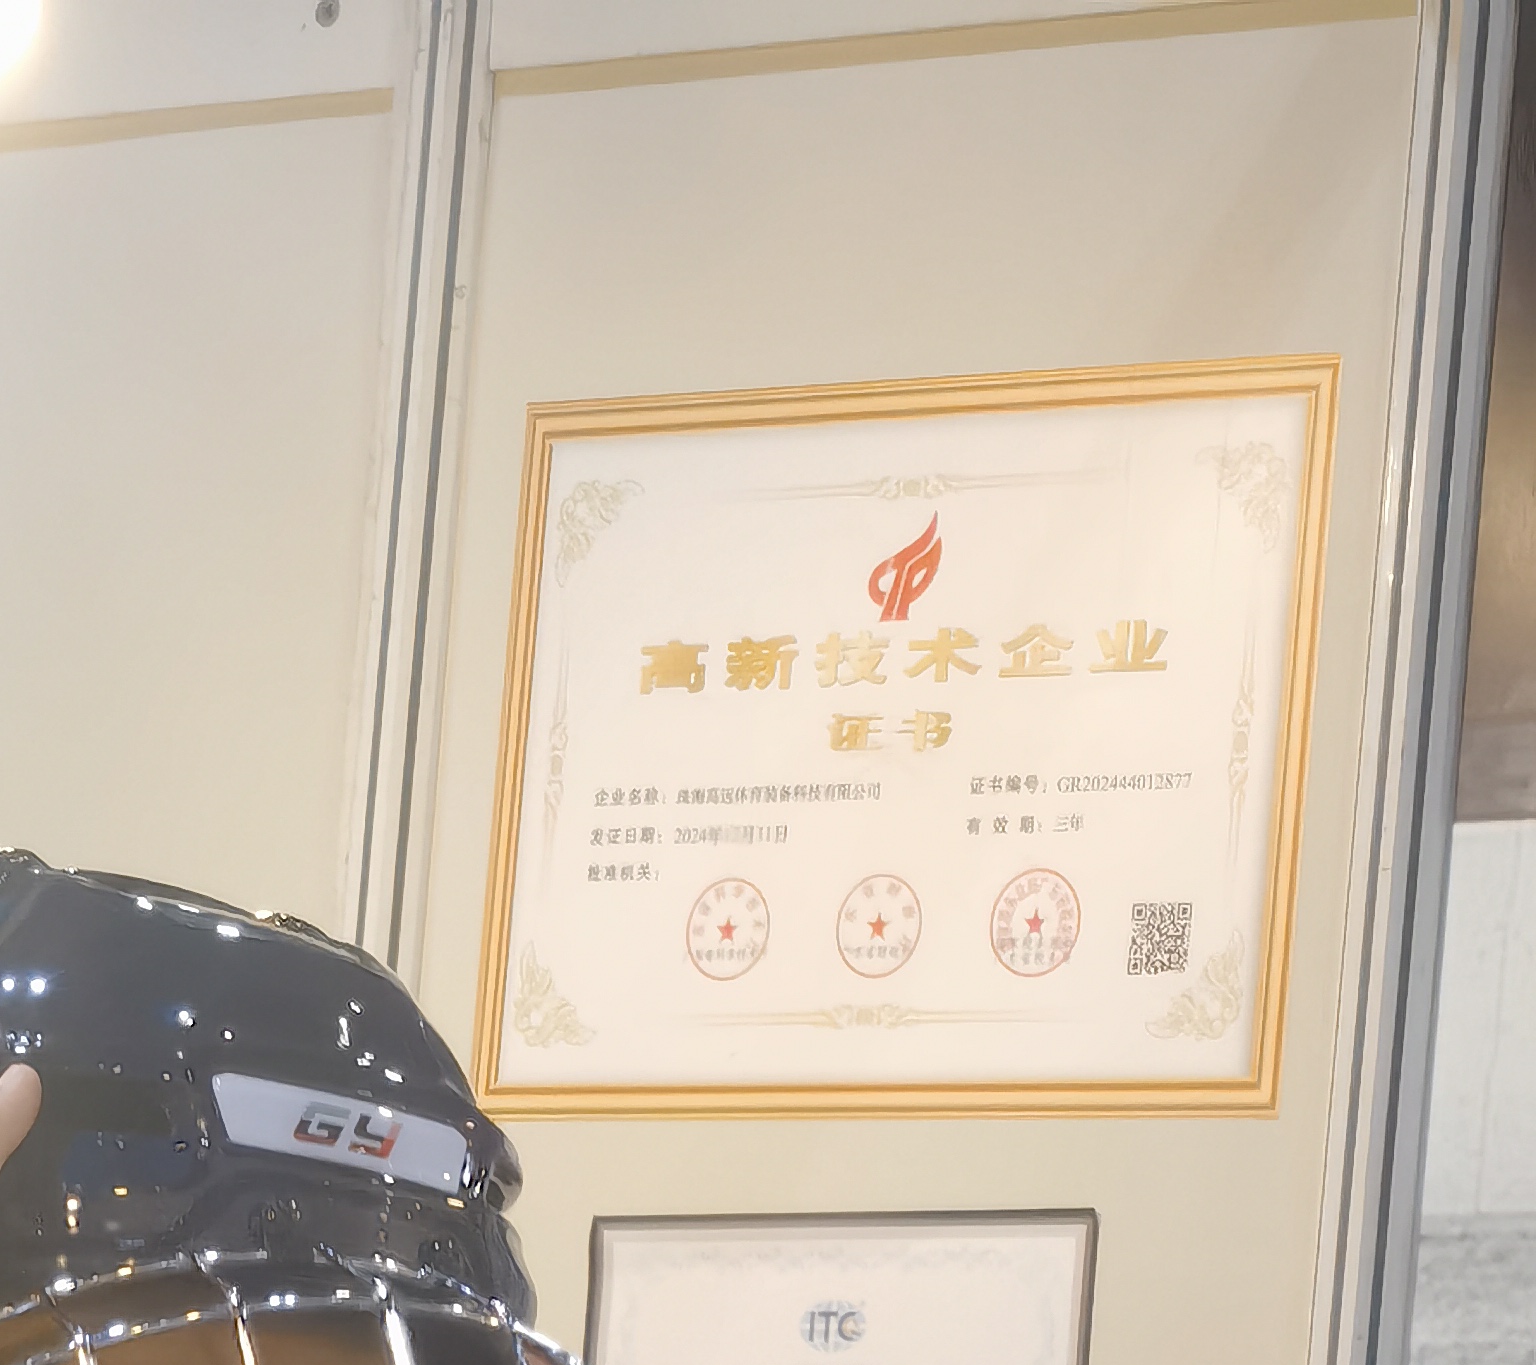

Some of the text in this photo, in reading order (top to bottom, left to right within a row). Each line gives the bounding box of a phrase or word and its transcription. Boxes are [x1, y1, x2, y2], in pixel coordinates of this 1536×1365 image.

[638, 618, 1169, 696] 高新技术企业
[826, 708, 954, 753] 证书
